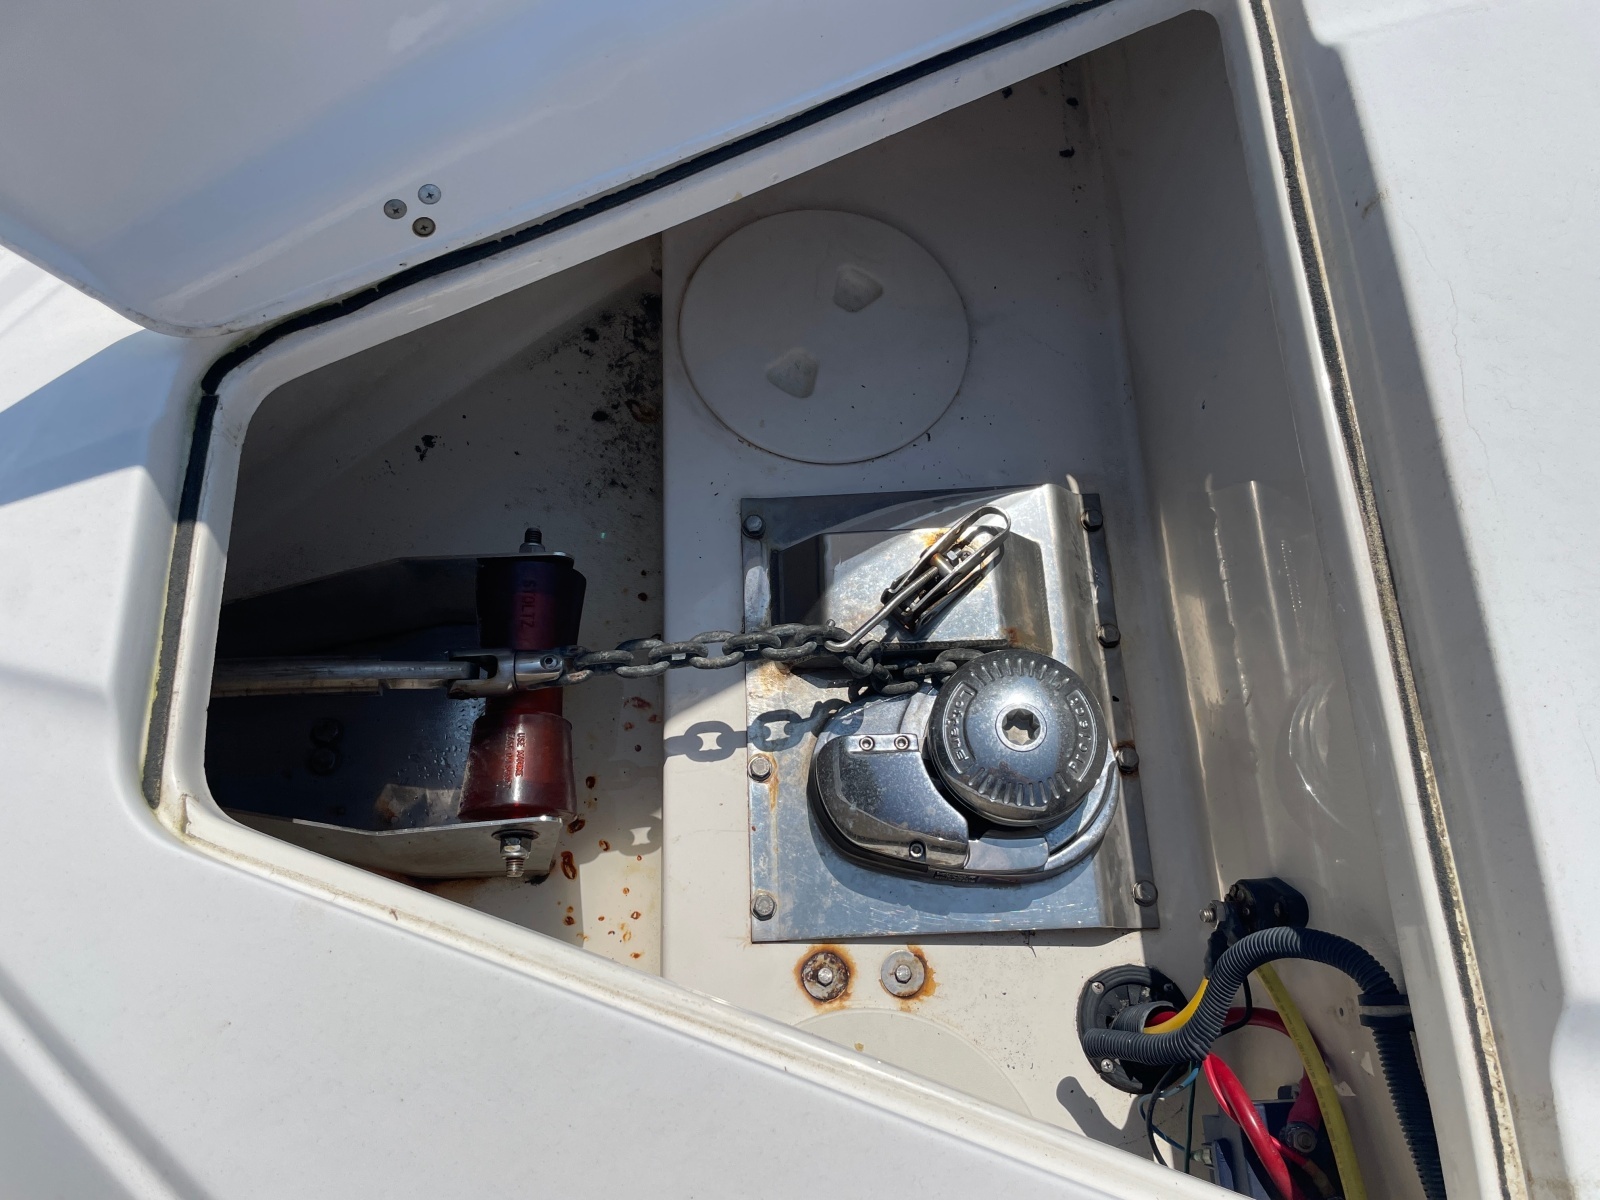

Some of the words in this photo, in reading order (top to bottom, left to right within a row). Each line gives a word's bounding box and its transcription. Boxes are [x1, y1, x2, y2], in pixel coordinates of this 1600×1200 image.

[520, 579, 537, 629] STOLTZ
[516, 732, 525, 748] USE
[1067, 697, 1092, 774] Project
[515, 750, 525, 778] MARINE
